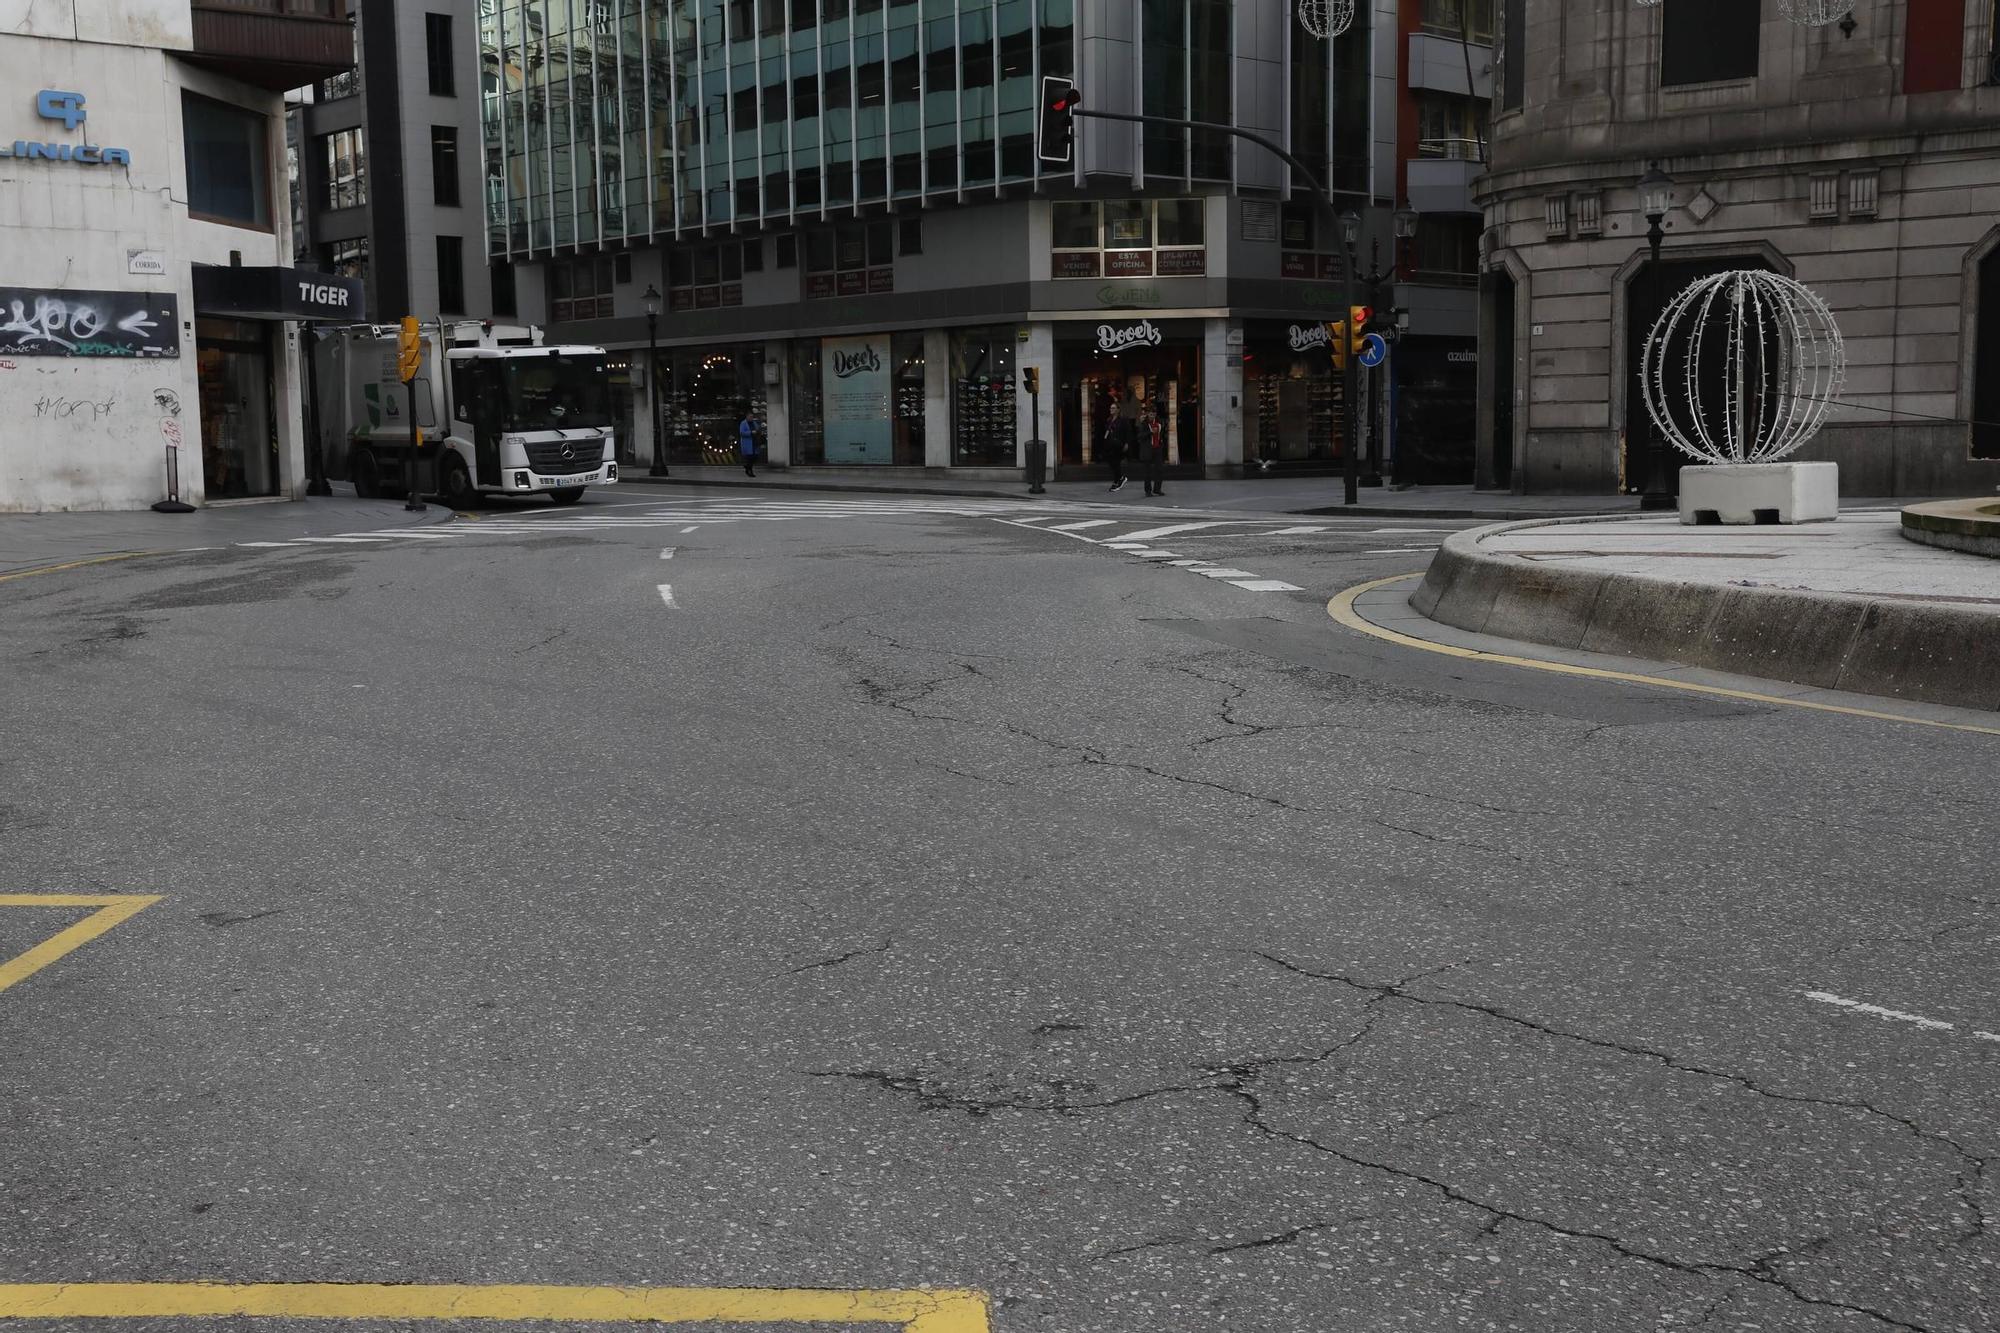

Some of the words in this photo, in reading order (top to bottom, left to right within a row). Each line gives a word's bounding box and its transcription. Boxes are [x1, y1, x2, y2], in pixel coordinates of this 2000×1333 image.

[1118, 252, 1140, 260] ESTA
[1111, 260, 1146, 269] OFICINA
[298, 282, 349, 307] TIGER
